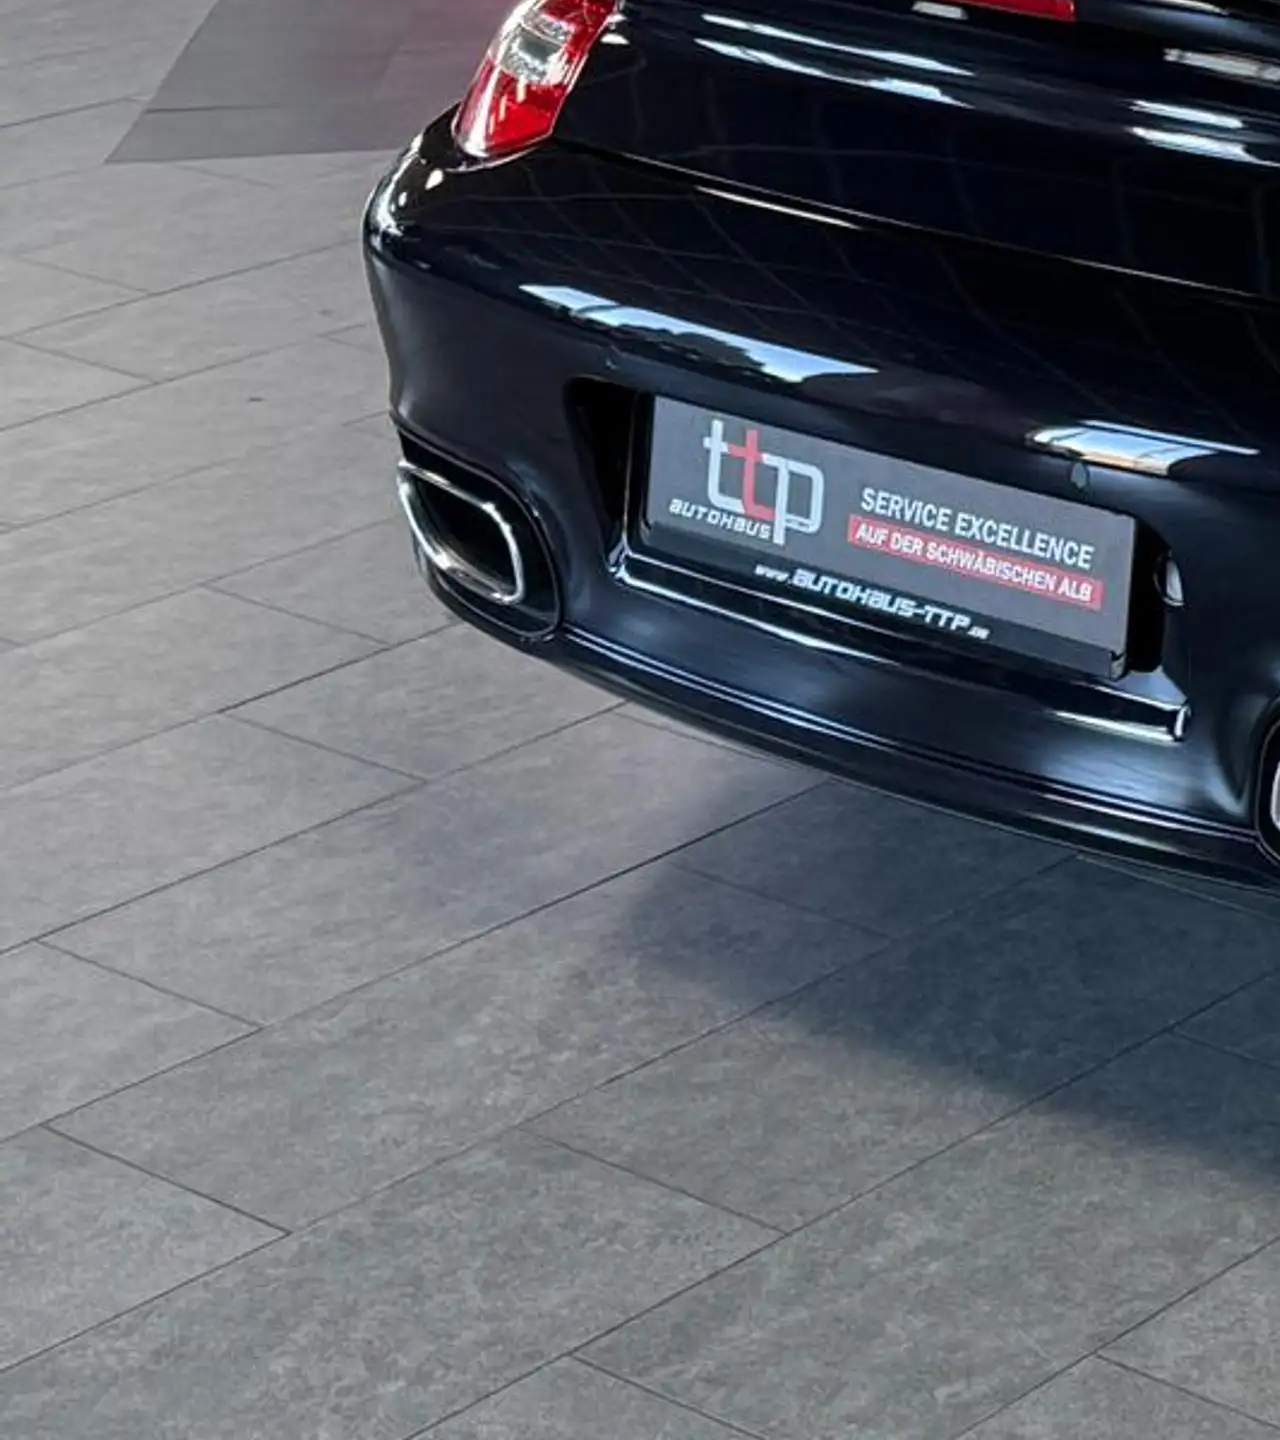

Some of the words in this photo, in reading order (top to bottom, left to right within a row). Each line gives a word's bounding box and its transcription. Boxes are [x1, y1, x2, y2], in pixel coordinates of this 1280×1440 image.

[703, 419, 825, 546] ttp
[856, 522, 889, 546] AUF
[890, 533, 928, 555] DER
[926, 541, 1058, 591] SCHWÄBISCHEN
[1057, 578, 1093, 602] ALB
[861, 487, 951, 532] SERVICE
[954, 511, 1095, 569] EXCELLENCE
